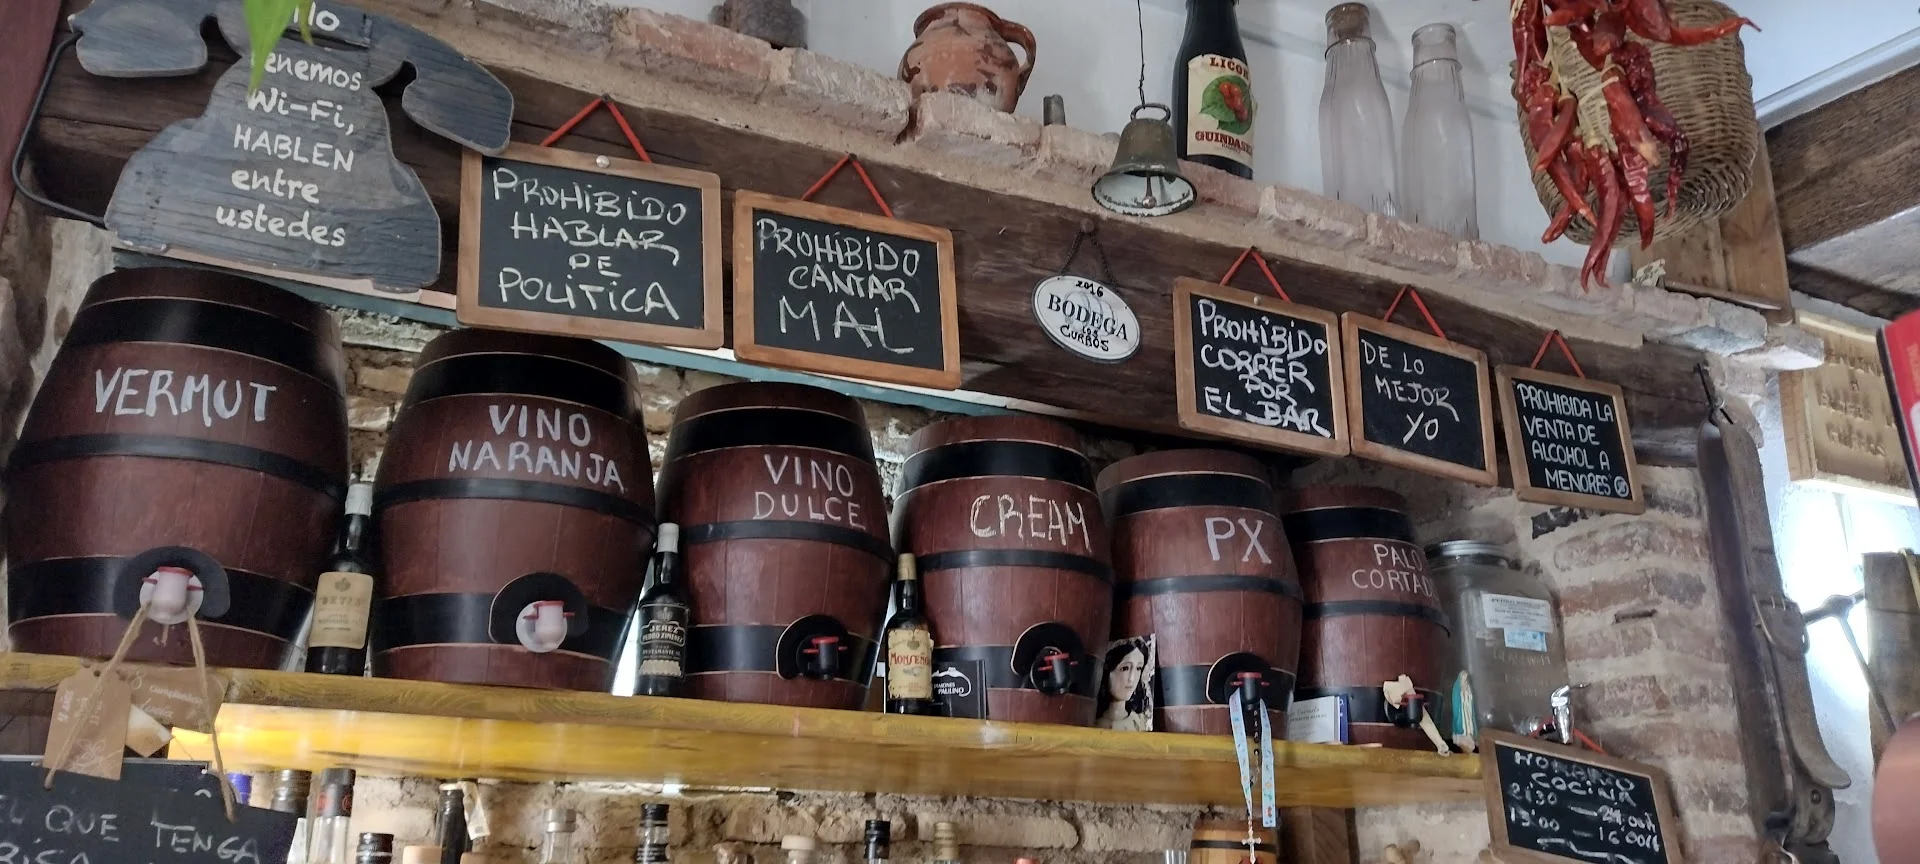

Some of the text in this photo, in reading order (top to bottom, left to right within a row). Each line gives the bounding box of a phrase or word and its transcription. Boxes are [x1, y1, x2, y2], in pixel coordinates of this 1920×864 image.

[250, 52, 362, 91] enemos
[234, 124, 355, 173] HABLEN
[231, 166, 320, 204] entre
[216, 204, 346, 247] ustedes
[511, 211, 680, 267] HABLAR
[568, 253, 623, 278] DE
[788, 265, 921, 314] CANTAR
[779, 296, 915, 354] MAL
[1047, 293, 1128, 342] BODEGA
[1200, 343, 1316, 394] CORRER
[1361, 338, 1425, 375] DE LO
[95, 366, 278, 428] VERMUT
[1238, 373, 1298, 406] POR
[1374, 373, 1460, 423] MEJOR
[1516, 383, 1614, 422] PROHIBIDA LA
[488, 403, 592, 447] VINO
[1204, 386, 1332, 438] EL BAR
[1402, 411, 1440, 445] YO
[1523, 415, 1600, 446] VENTA DE
[448, 439, 627, 495] NARANJA
[763, 453, 854, 498] VINO
[1531, 440, 1611, 471] ALCOHOL A
[1545, 468, 1611, 496] MENORES
[753, 490, 867, 530] DULCE
[970, 493, 1092, 552] CREAM
[1204, 516, 1272, 564] PX
[1373, 543, 1423, 572] PALO
[649, 624, 679, 634] JEREZ
[45, 804, 119, 842] QUE
[150, 817, 261, 864] TENGA
